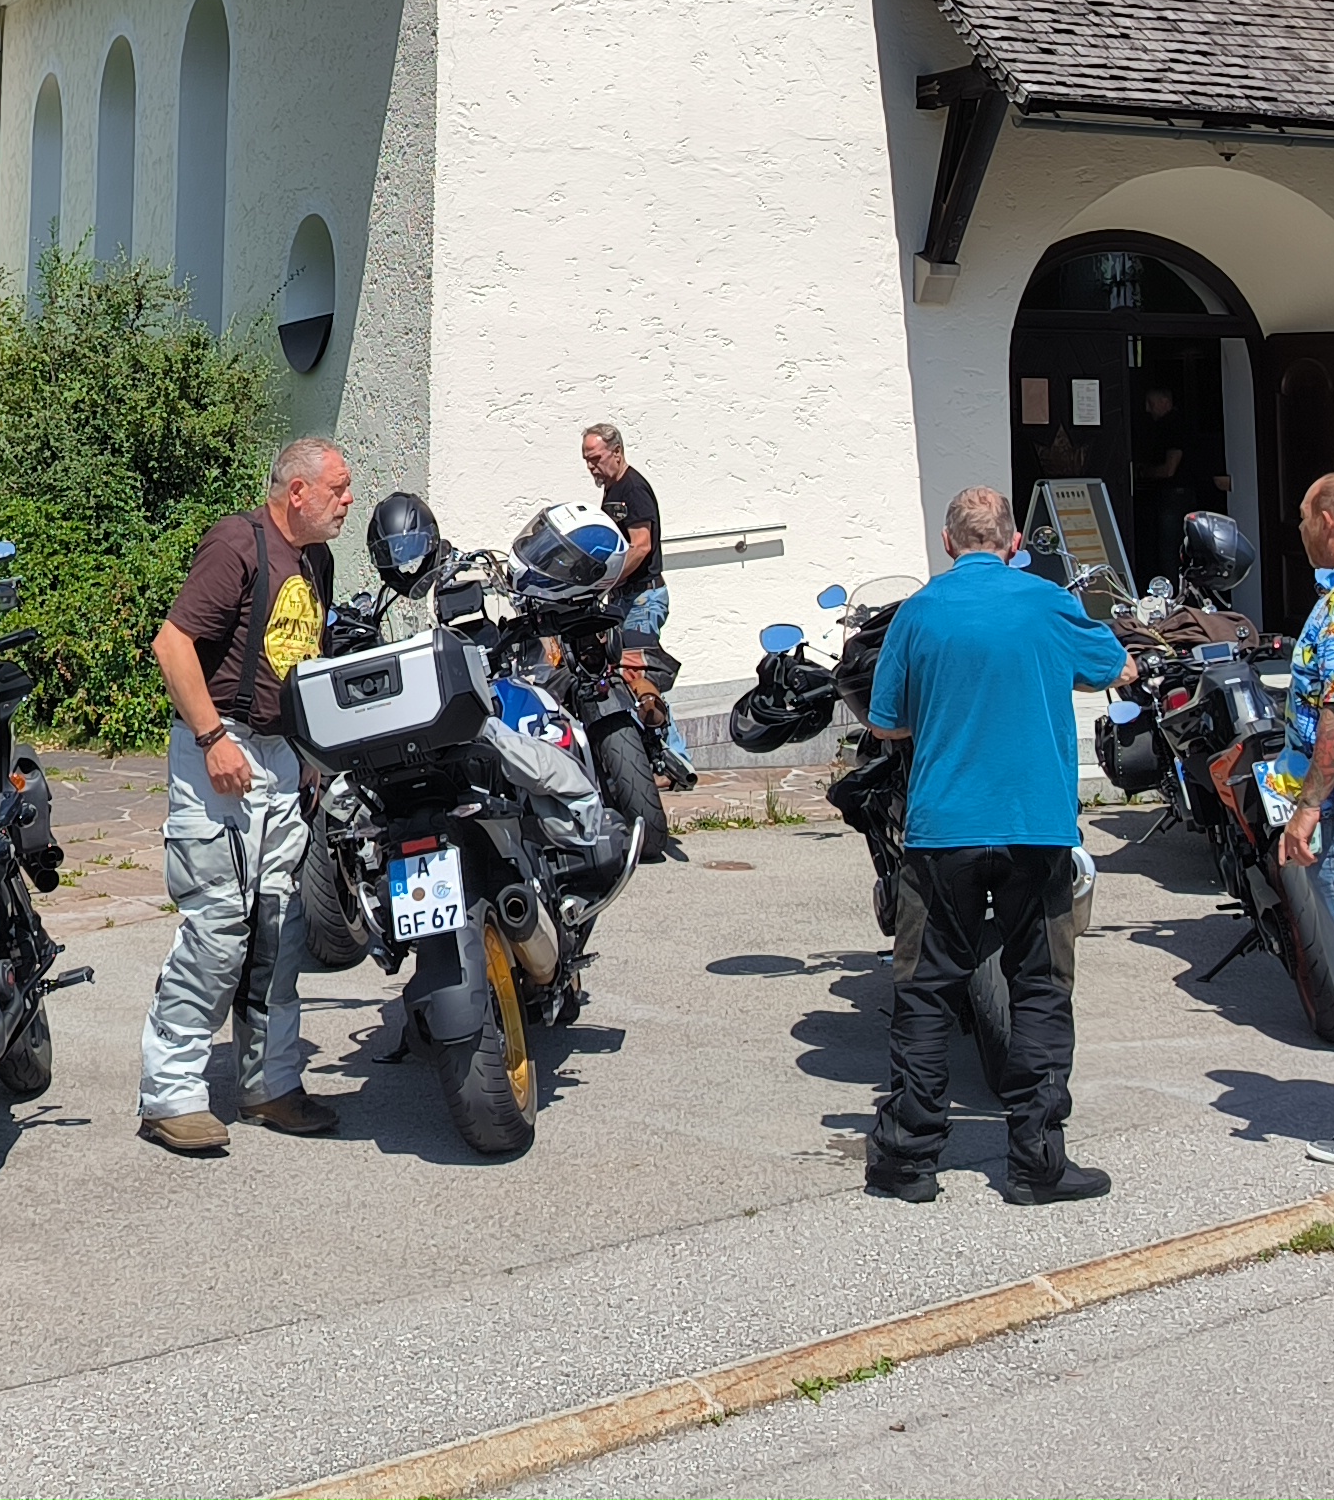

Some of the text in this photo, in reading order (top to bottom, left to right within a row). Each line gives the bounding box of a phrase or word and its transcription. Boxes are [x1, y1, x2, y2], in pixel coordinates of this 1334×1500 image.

[417, 856, 430, 879] A
[397, 903, 458, 936] GF 67
